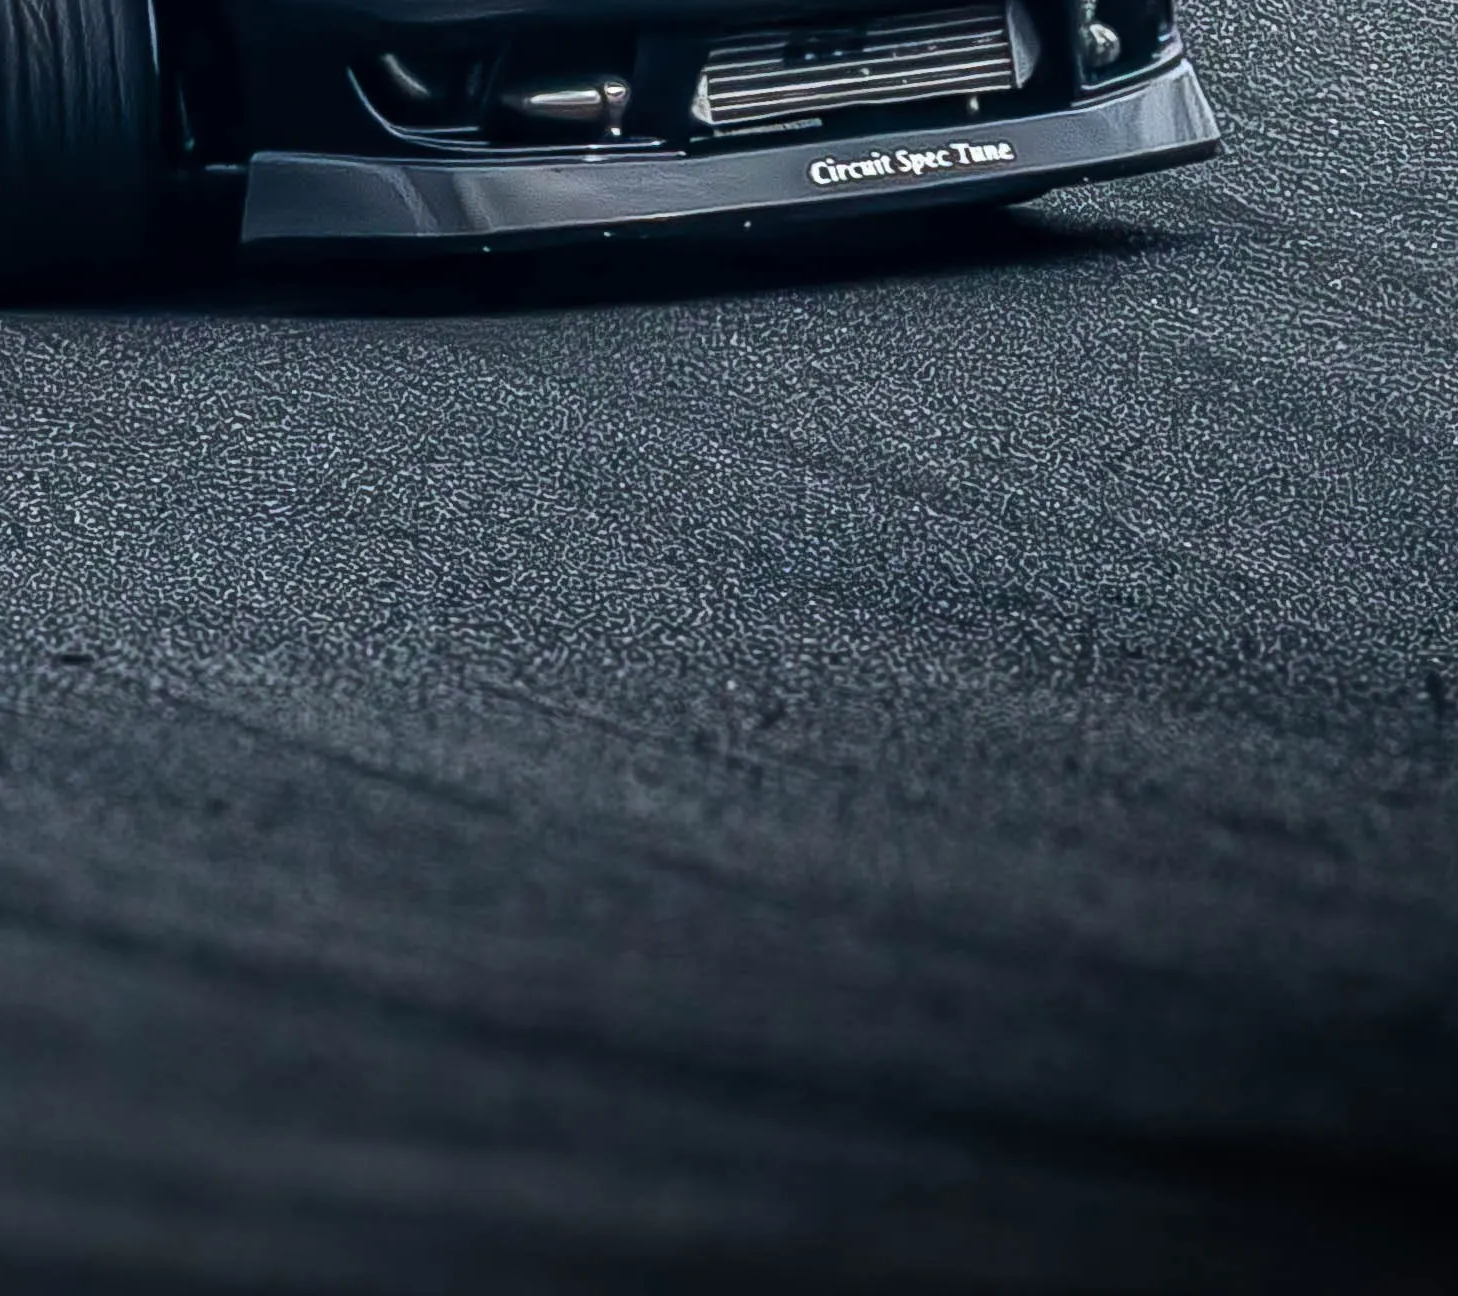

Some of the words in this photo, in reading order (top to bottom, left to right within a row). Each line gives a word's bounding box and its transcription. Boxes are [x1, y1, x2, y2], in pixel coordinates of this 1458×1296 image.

[809, 151, 895, 185] Circuit
[894, 148, 954, 175] Spec
[948, 141, 1015, 166] Tune
